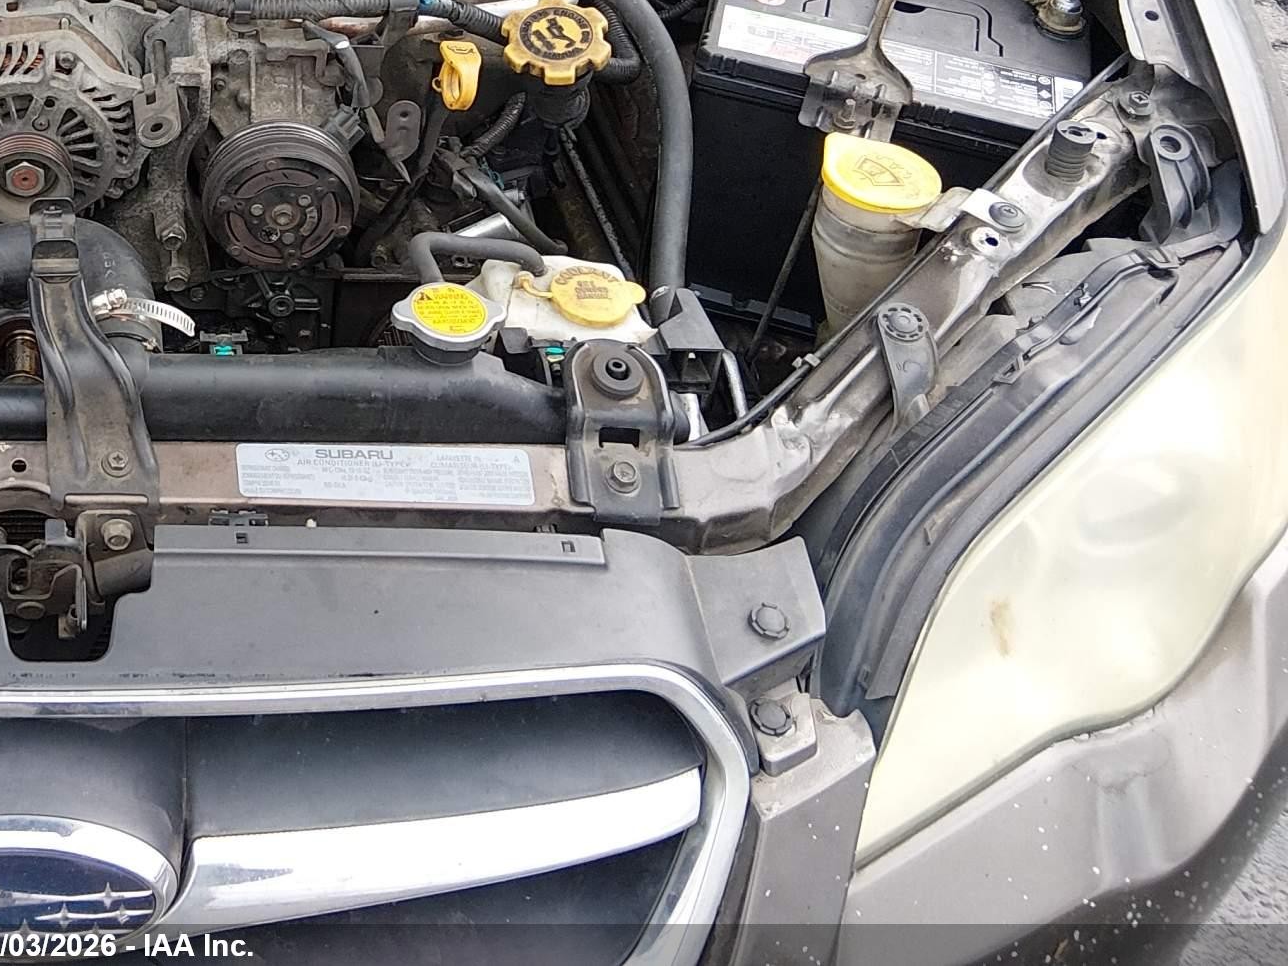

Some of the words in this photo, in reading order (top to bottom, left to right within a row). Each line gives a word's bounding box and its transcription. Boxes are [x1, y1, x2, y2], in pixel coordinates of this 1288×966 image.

[314, 448, 394, 460] SUBARU
[297, 458, 311, 466] AIR
[313, 459, 370, 468] CONDITIONER
